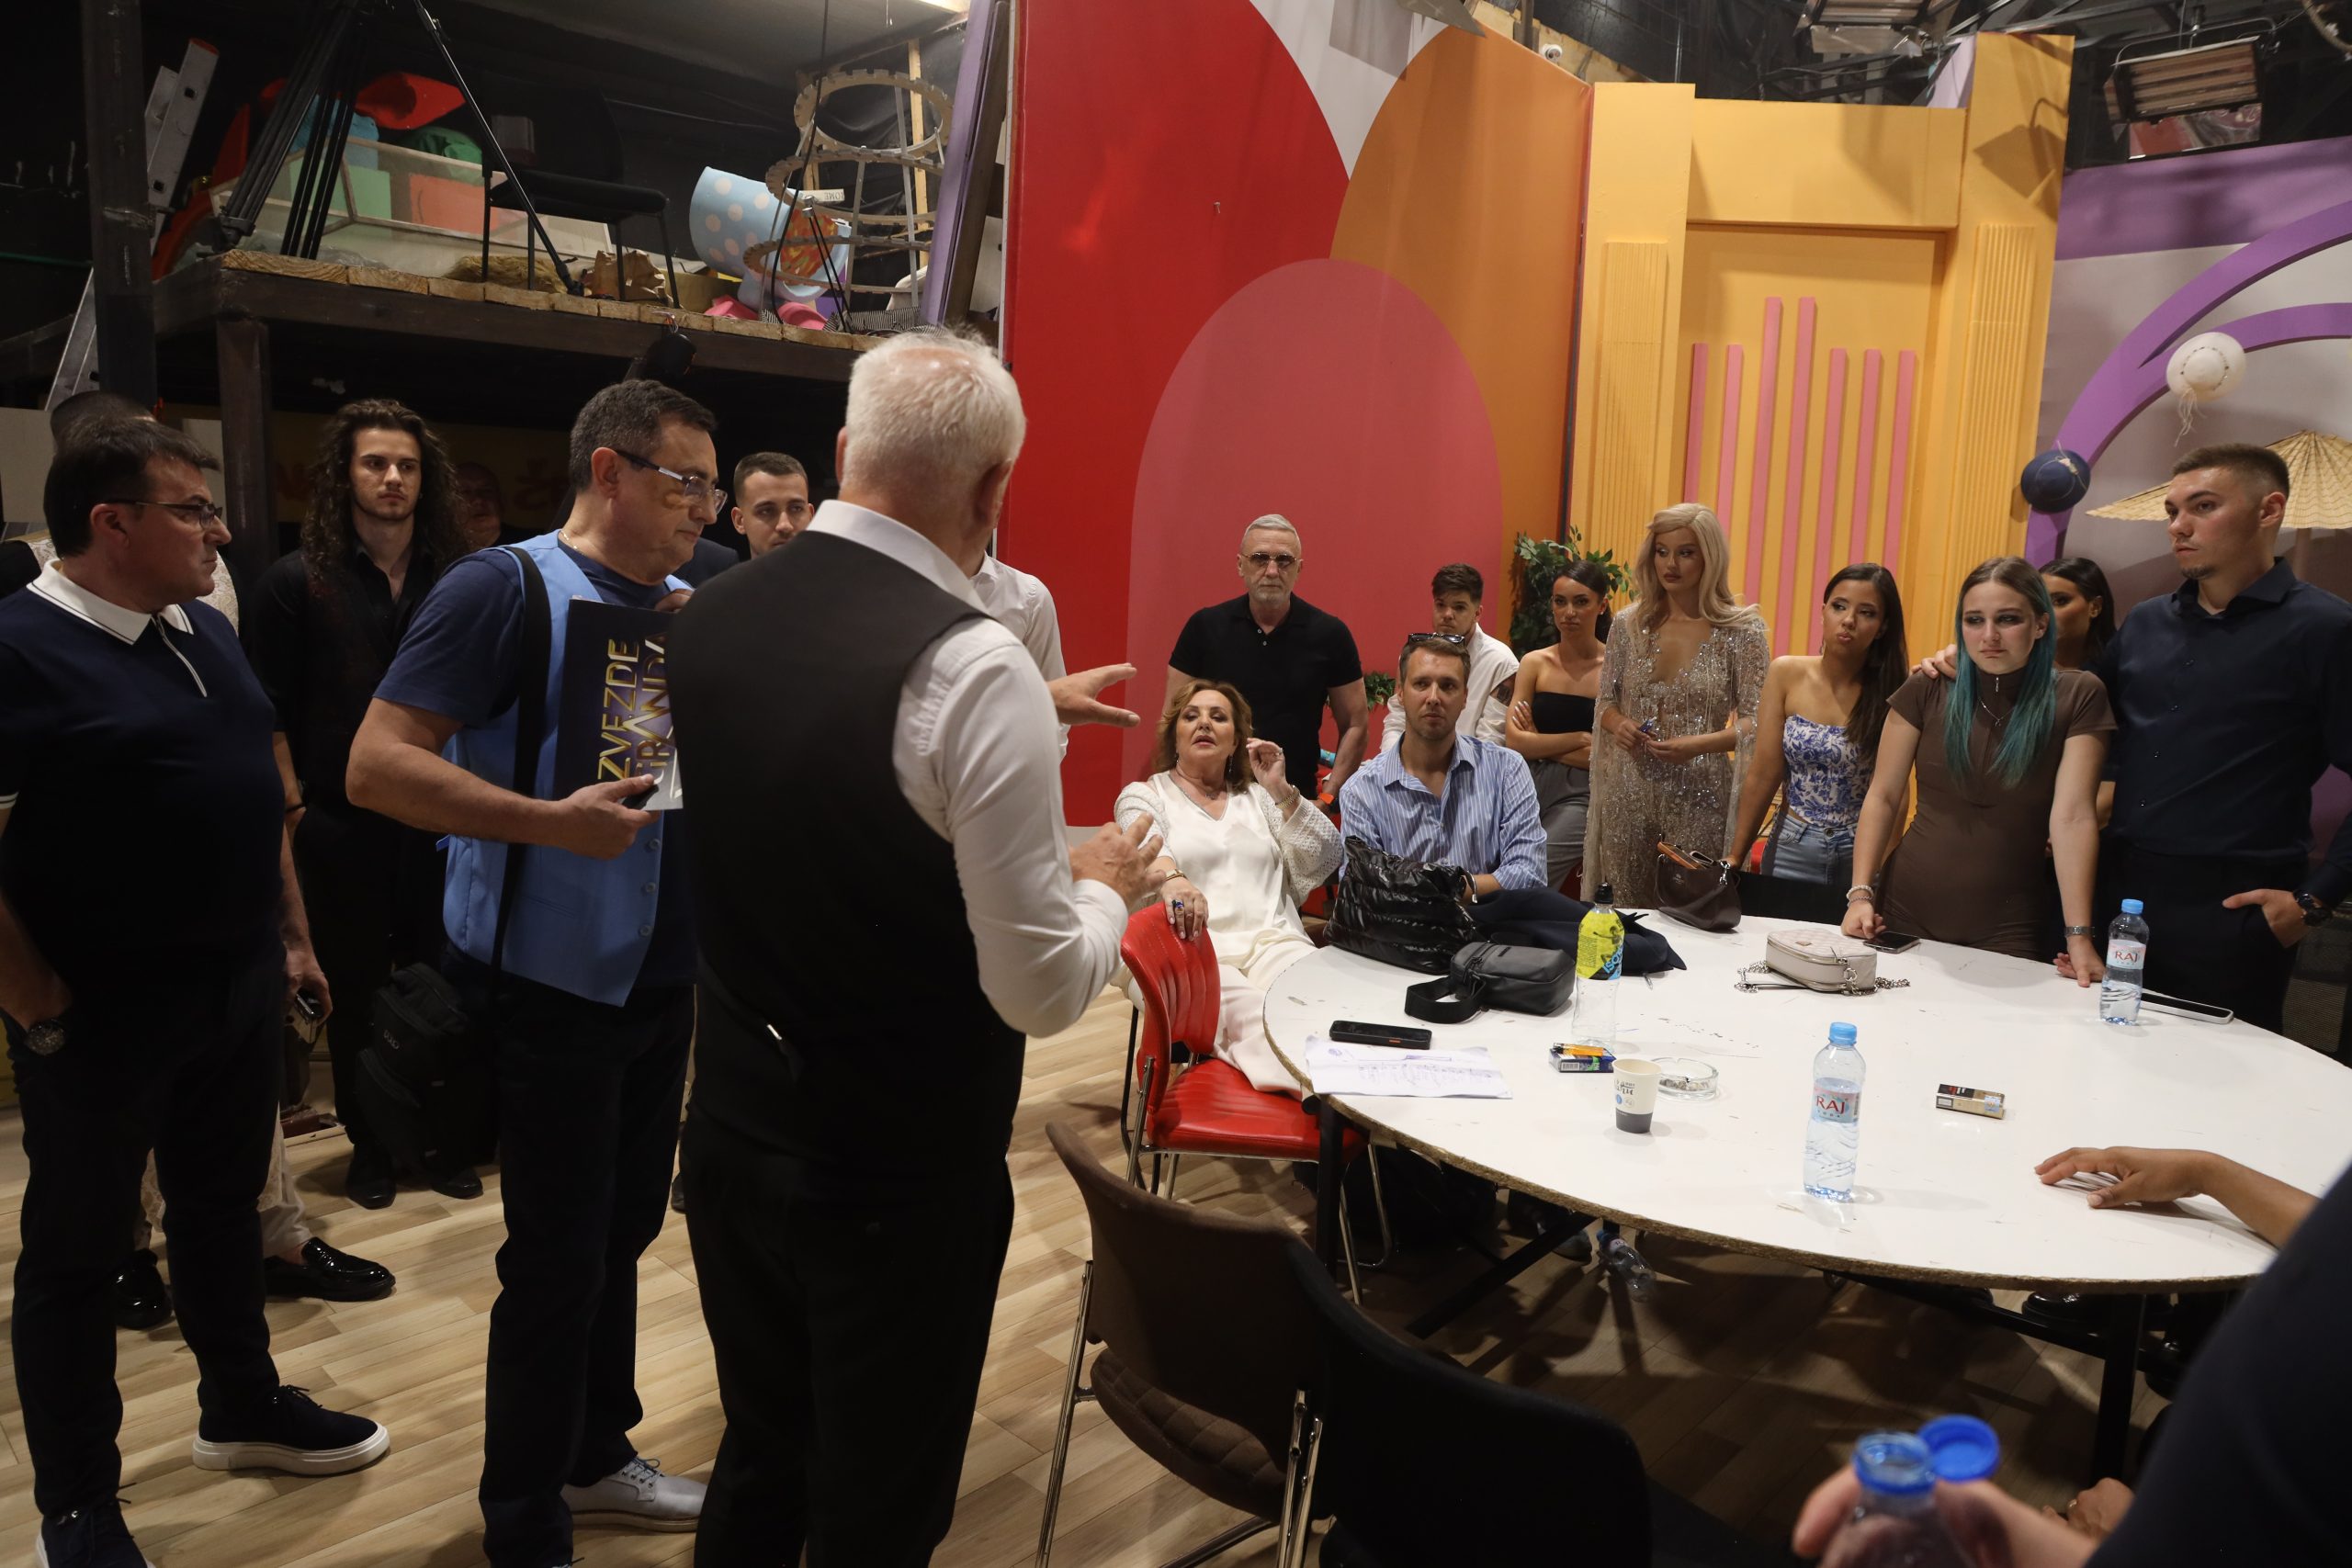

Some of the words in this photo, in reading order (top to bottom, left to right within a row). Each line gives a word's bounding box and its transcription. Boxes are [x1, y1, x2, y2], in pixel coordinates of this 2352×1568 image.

[597, 639, 639, 779] ZVEZDE
[2115, 951, 2138, 963] RAJ
[1815, 1095, 1846, 1114] RAJ
